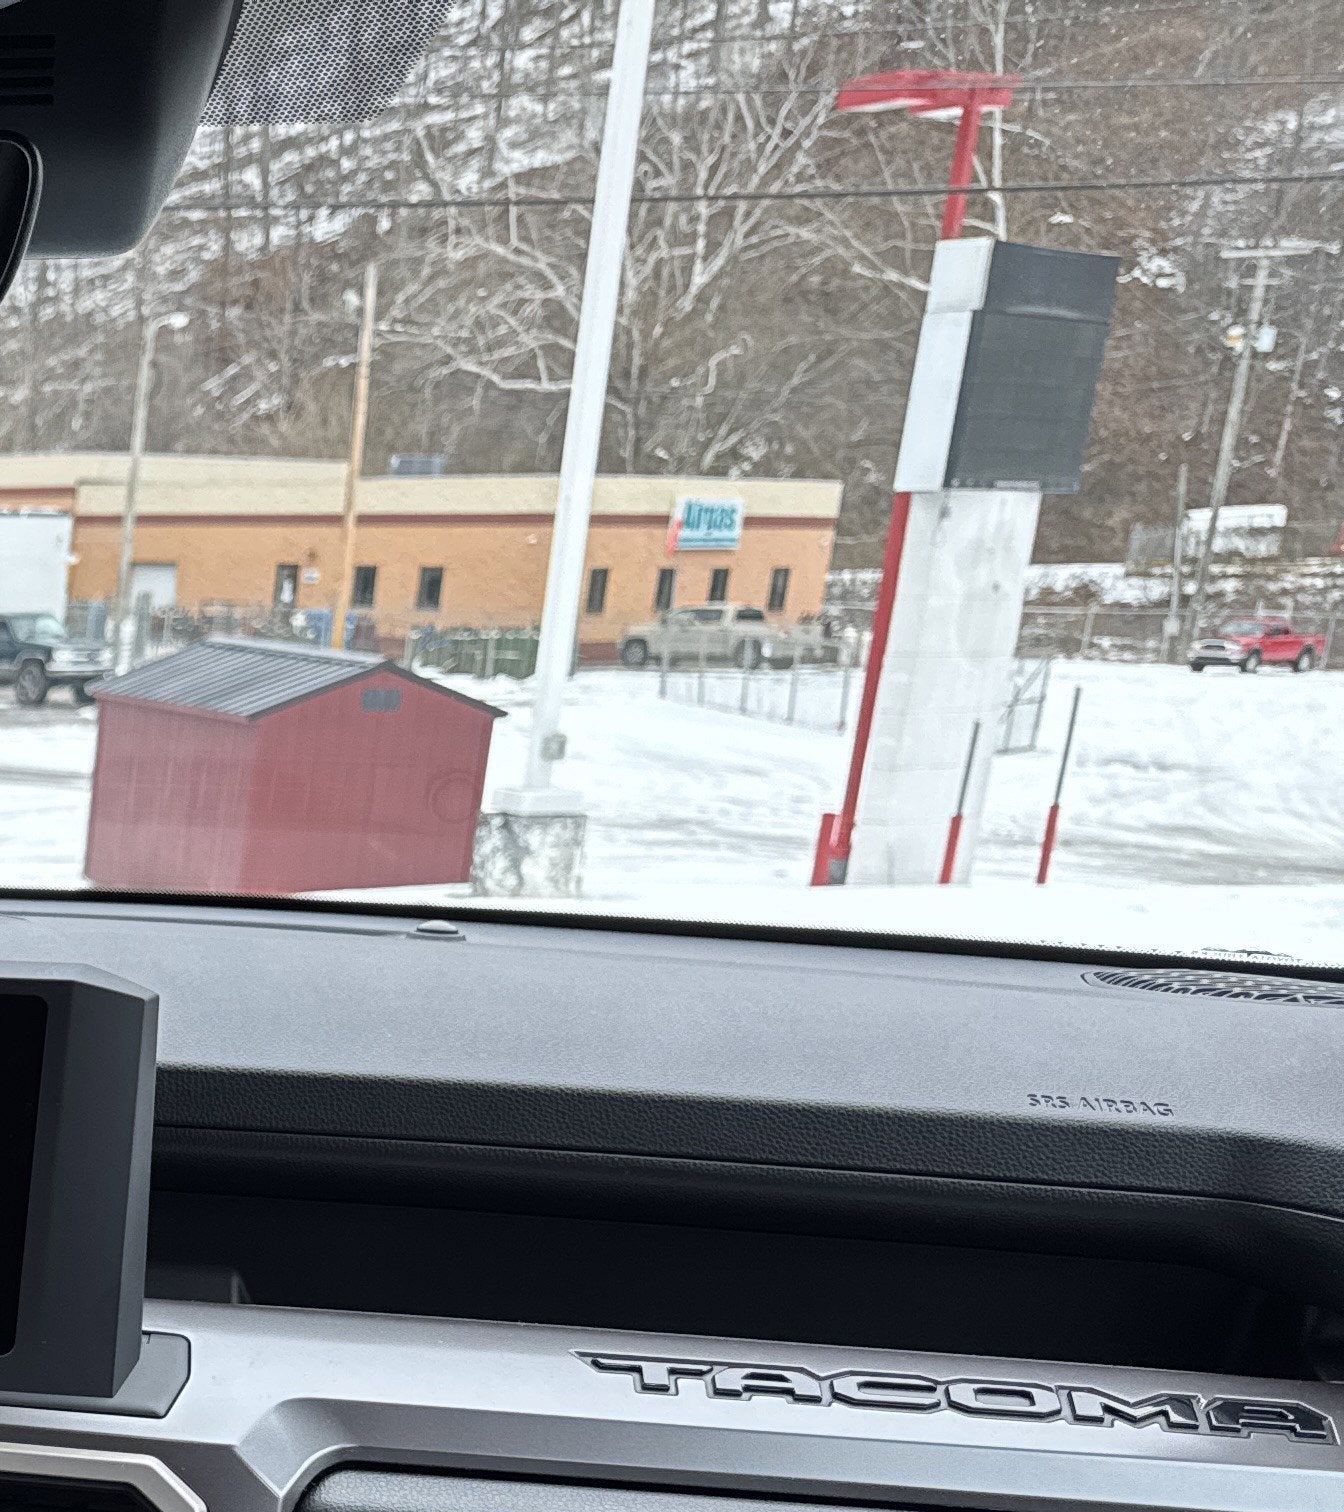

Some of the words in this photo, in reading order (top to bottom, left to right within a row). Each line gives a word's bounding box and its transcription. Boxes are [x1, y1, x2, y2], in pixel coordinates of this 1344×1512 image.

[1027, 1093, 1070, 1108] SRS
[1078, 1096, 1174, 1116] AIRBAG
[569, 1349, 1340, 1446] TACOMA
